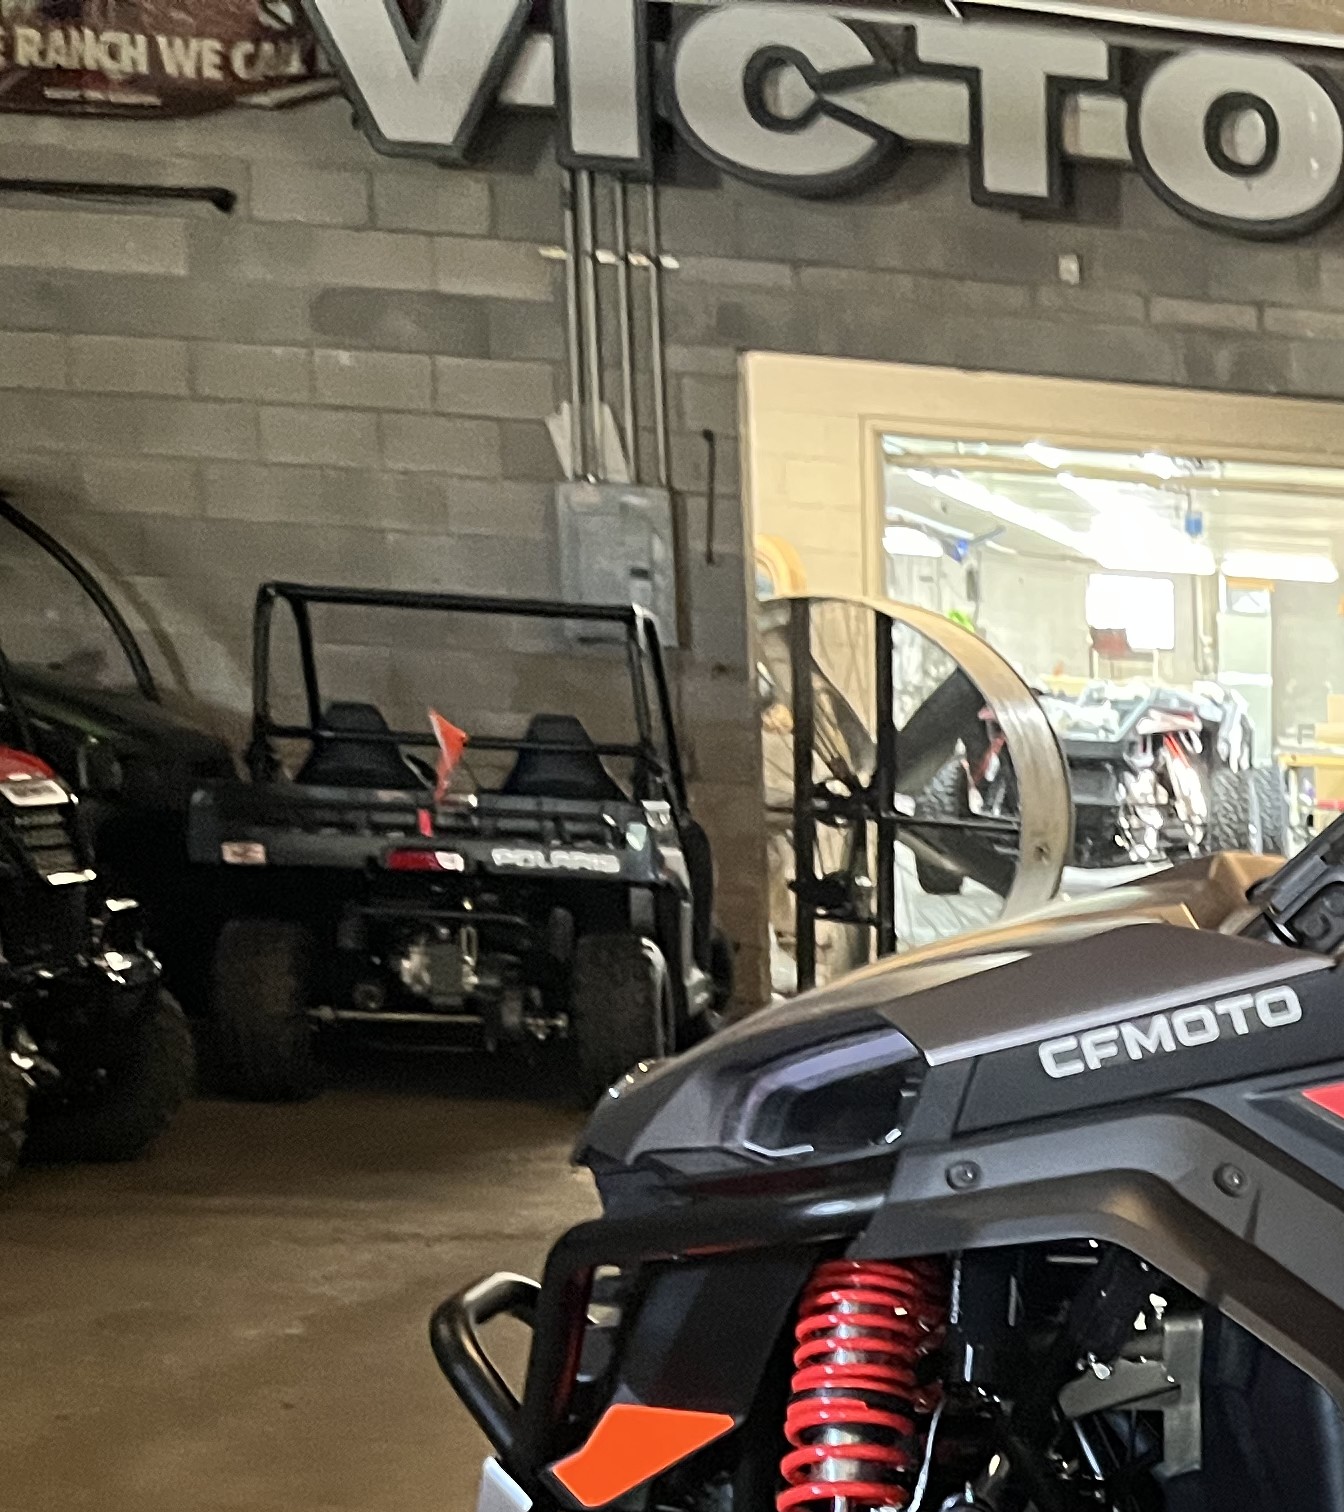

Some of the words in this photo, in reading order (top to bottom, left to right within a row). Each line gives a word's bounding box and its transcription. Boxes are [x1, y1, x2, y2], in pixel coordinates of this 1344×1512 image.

[14, 26, 149, 77] RANCH
[156, 34, 225, 80] WE
[1038, 984, 1303, 1079] CFMOTO
